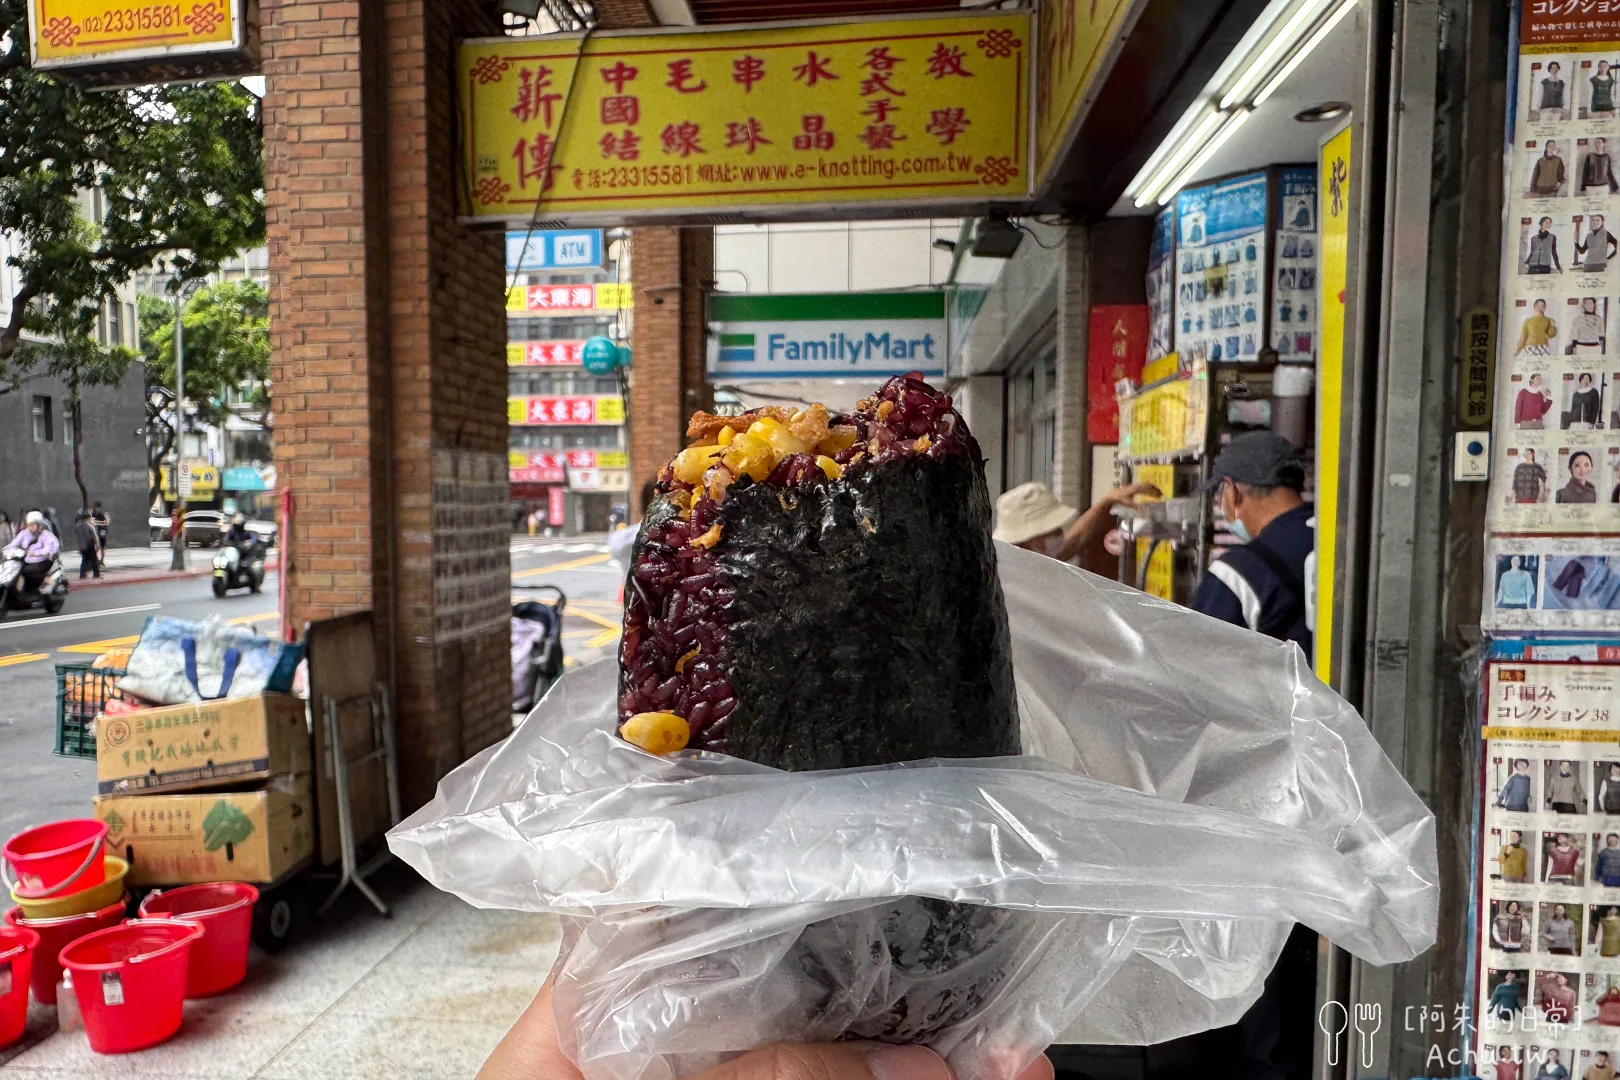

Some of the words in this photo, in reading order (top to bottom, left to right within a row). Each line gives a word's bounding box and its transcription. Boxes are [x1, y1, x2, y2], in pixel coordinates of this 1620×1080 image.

[82, 4, 181, 34] (02)23315581
[599, 61, 641, 161] 中國結
[660, 58, 706, 157] 毛線
[792, 51, 839, 150] 水晶
[857, 46, 906, 149] 各式手藝
[925, 42, 975, 146] 教學
[560, 241, 585, 258] ATM
[767, 331, 935, 364] FamilyMart
